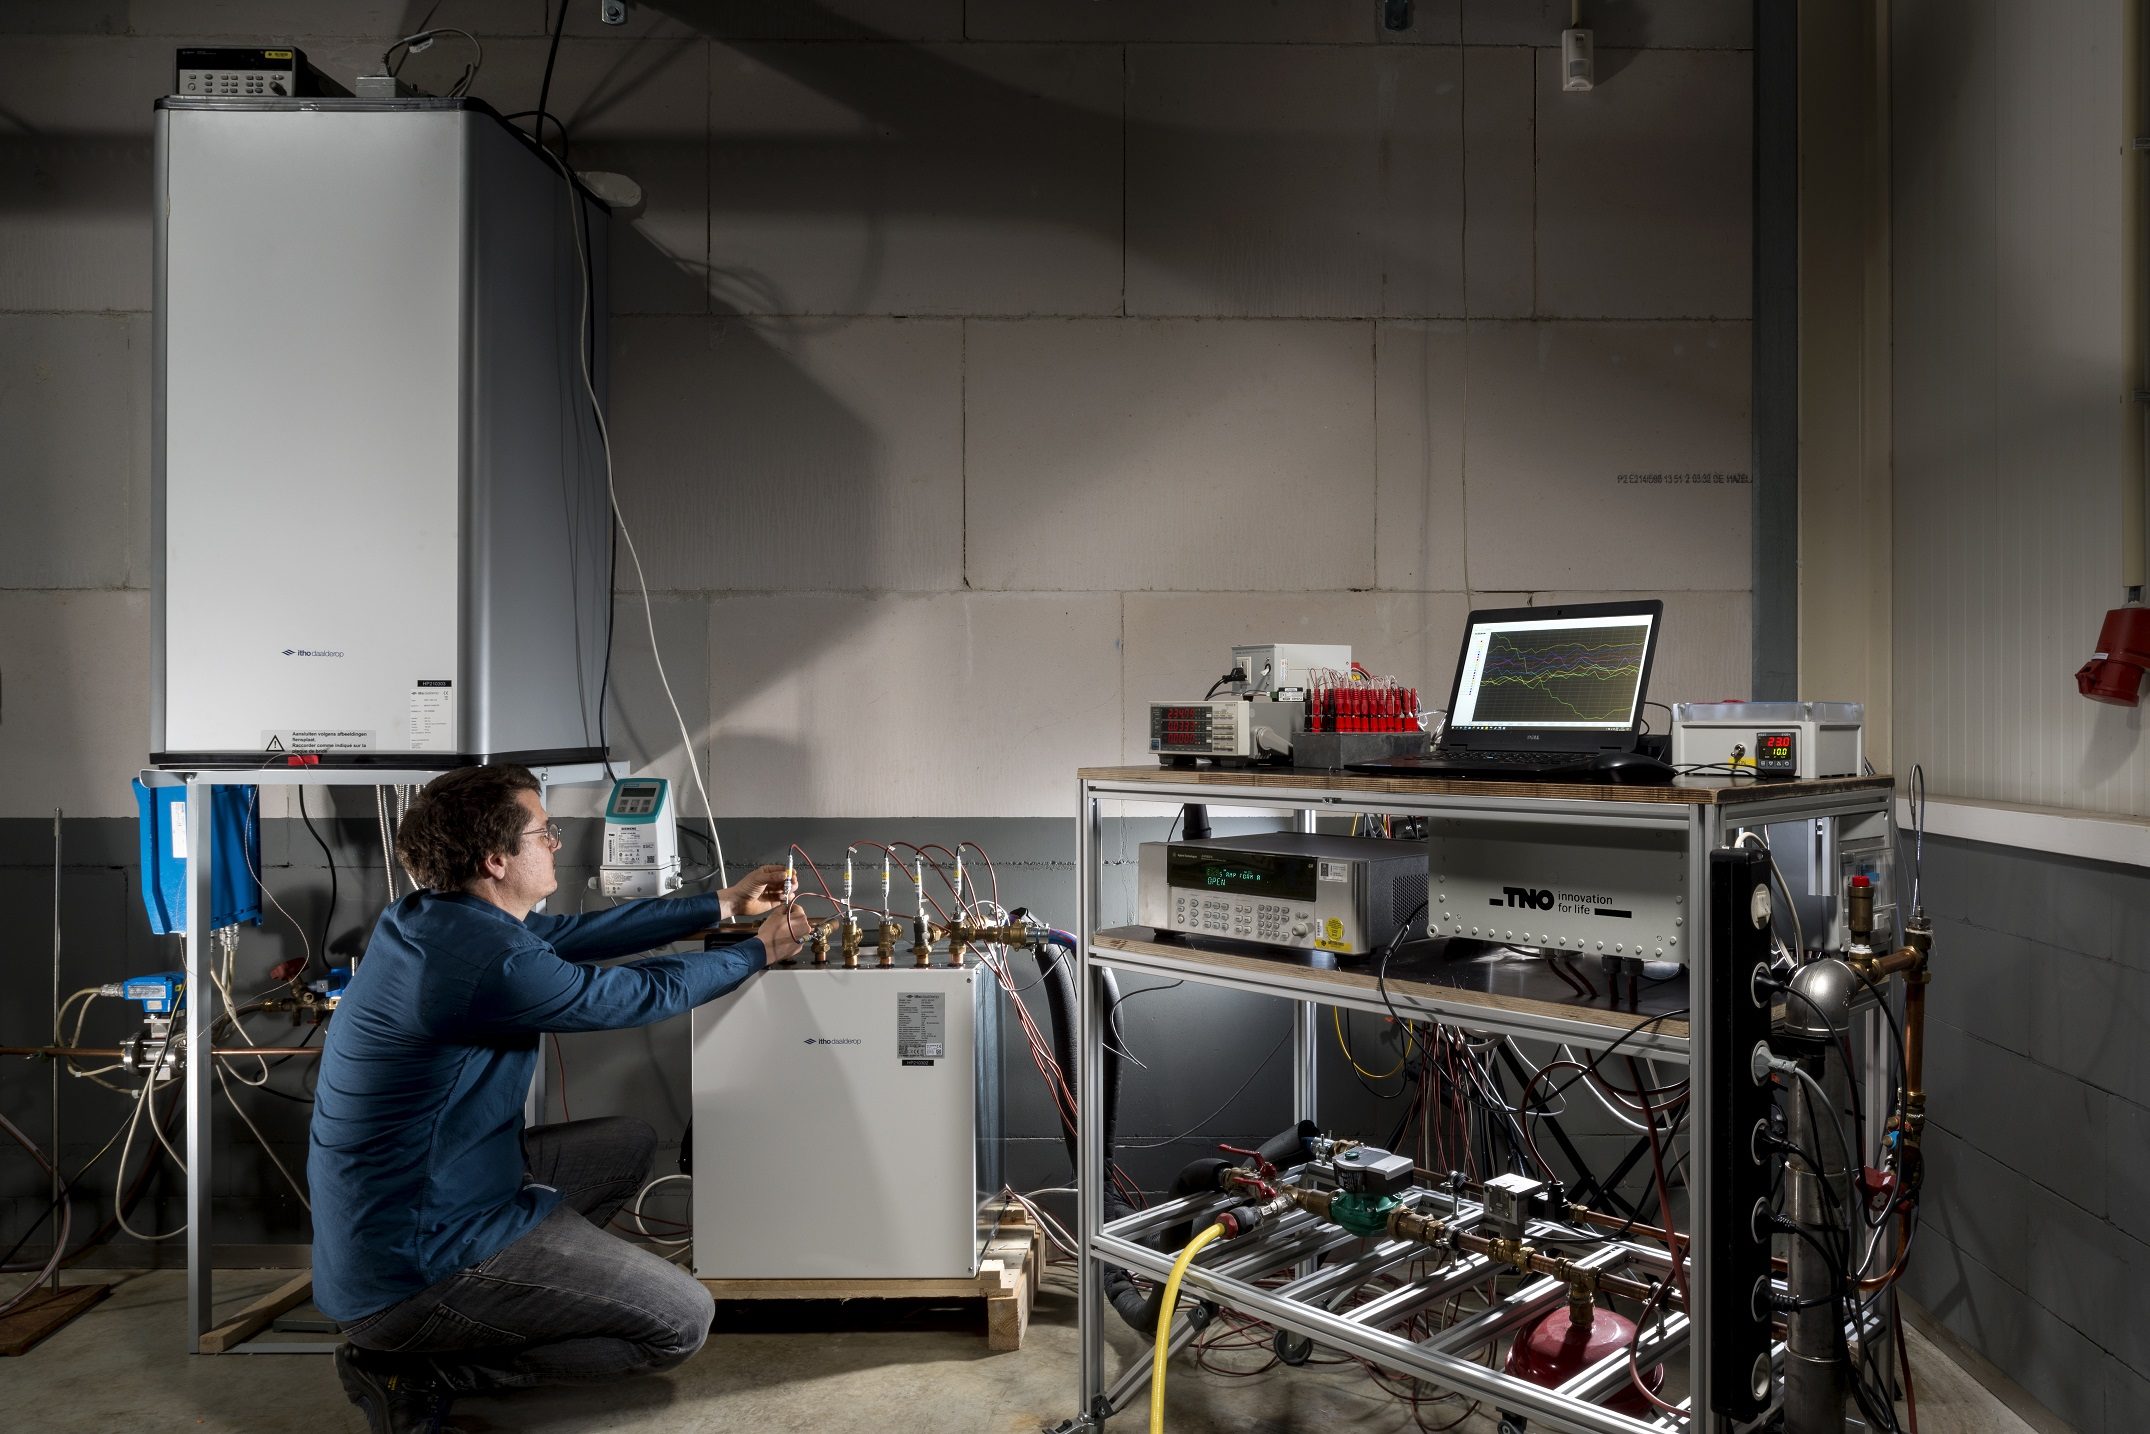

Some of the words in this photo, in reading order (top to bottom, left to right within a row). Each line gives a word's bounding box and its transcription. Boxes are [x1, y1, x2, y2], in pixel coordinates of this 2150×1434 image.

[1773, 747, 1788, 756] 10.0
[1207, 876, 1226, 886] OPEN
[1503, 886, 1555, 911] TNO
[1558, 891, 1613, 905] innovation
[1558, 903, 1572, 913] for
[1574, 904, 1590, 915] life
